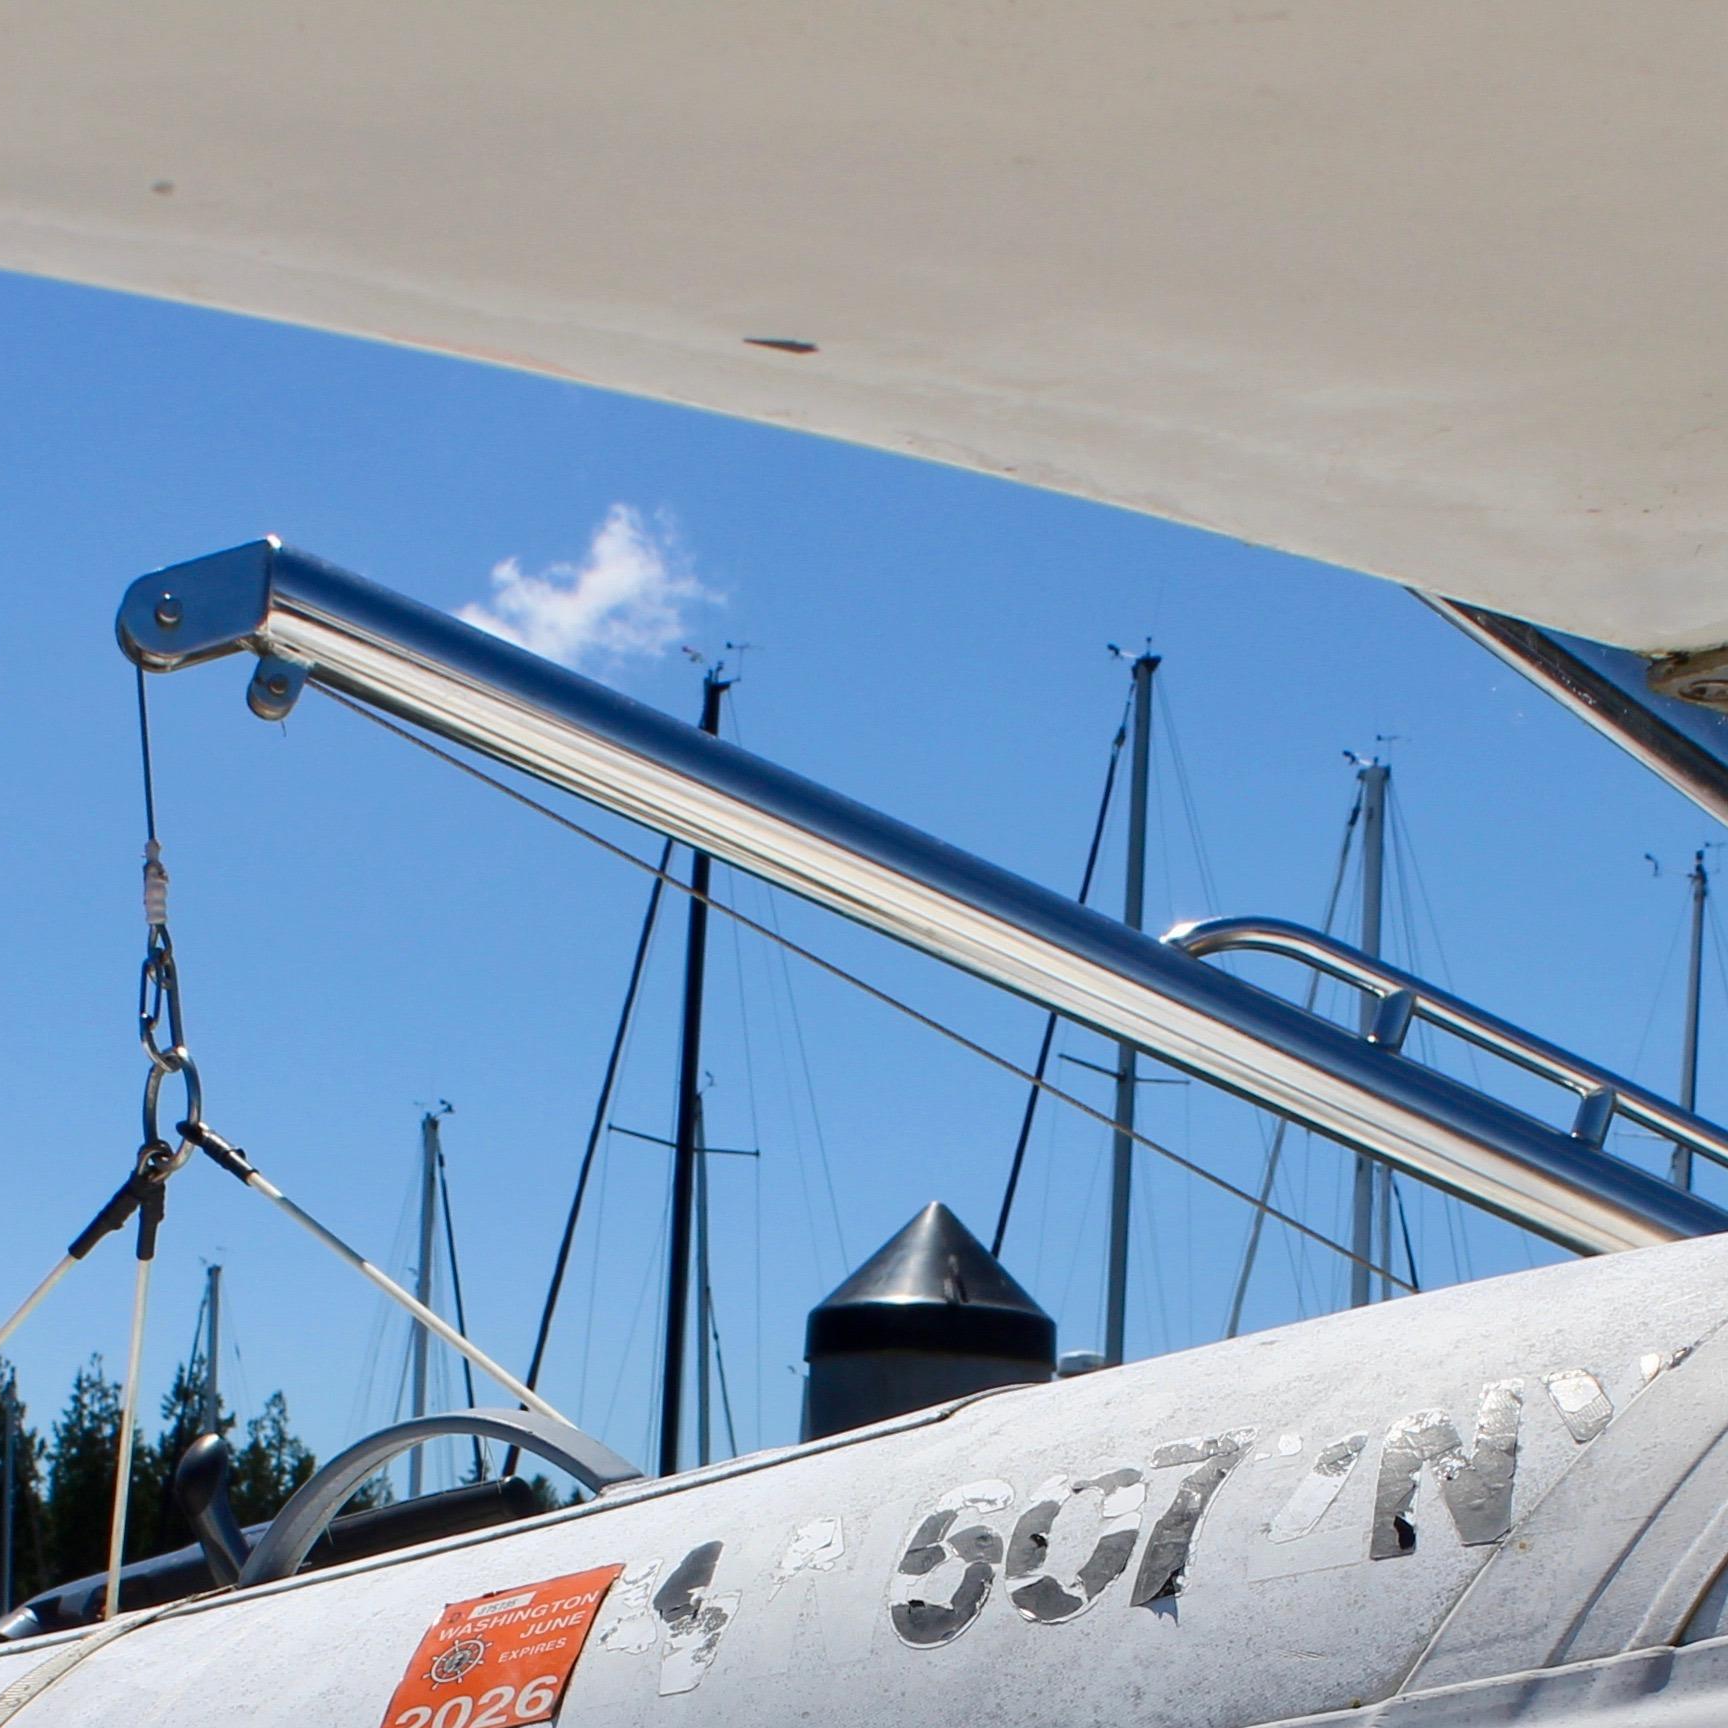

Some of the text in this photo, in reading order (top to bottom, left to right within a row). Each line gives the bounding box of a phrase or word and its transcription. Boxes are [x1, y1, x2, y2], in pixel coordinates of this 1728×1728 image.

[440, 1592, 598, 1641] WASHINGTON
[520, 1612, 584, 1639] JUNE
[498, 1638, 567, 1663] EXPIRES
